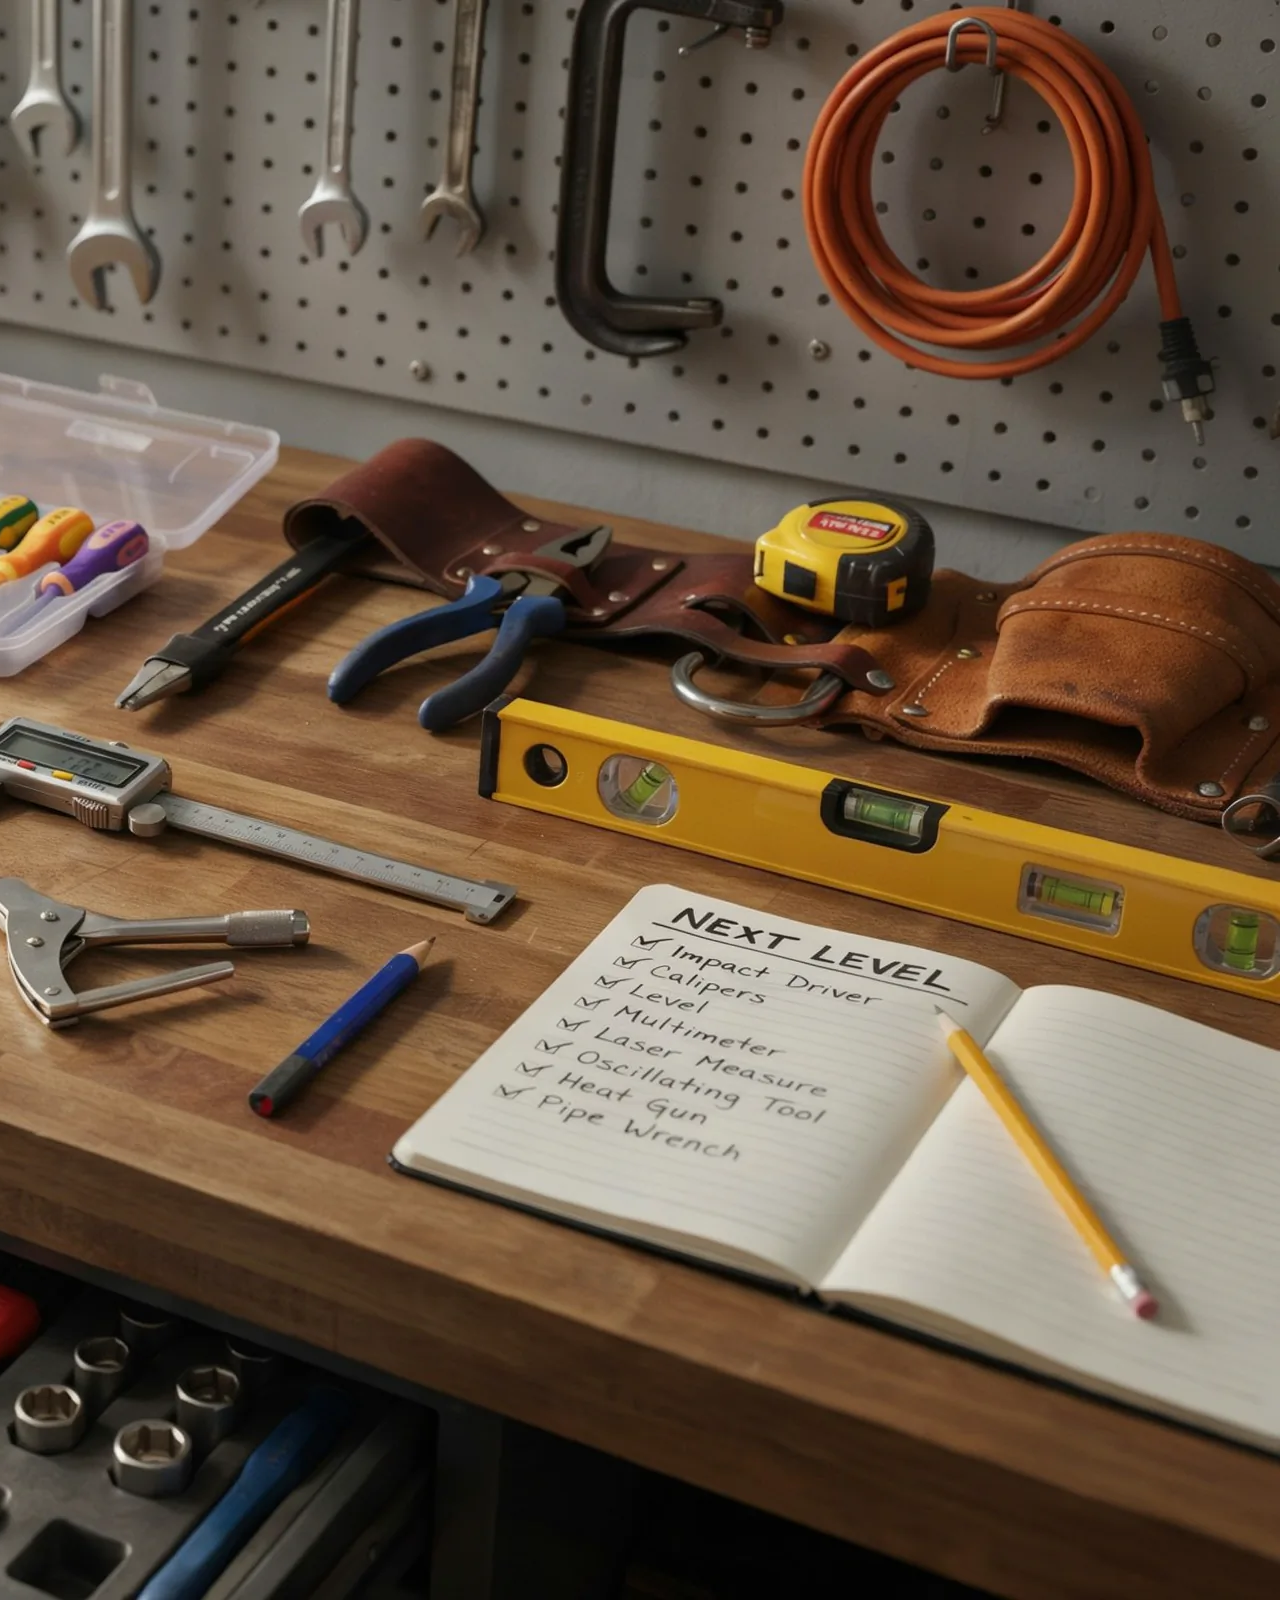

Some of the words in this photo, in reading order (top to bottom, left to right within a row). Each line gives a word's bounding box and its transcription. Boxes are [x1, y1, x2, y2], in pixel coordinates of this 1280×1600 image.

[671, 907, 801, 950] NEXT
[810, 945, 951, 992] LEVEL
[671, 945, 770, 978] Impact
[785, 974, 883, 1005] Driver
[629, 983, 709, 1014] Level
[650, 965, 766, 1004] Calipers
[613, 1005, 787, 1057] Multimeter
[577, 1051, 741, 1111] Oscillating
[764, 1095, 827, 1124] Tool
[594, 1027, 682, 1058] Laser
[695, 1055, 827, 1098] Measure
[538, 1094, 605, 1126] Pipe
[624, 1119, 741, 1162] Wrench
[558, 1072, 633, 1102] Heat
[646, 1098, 707, 1125] Gun
